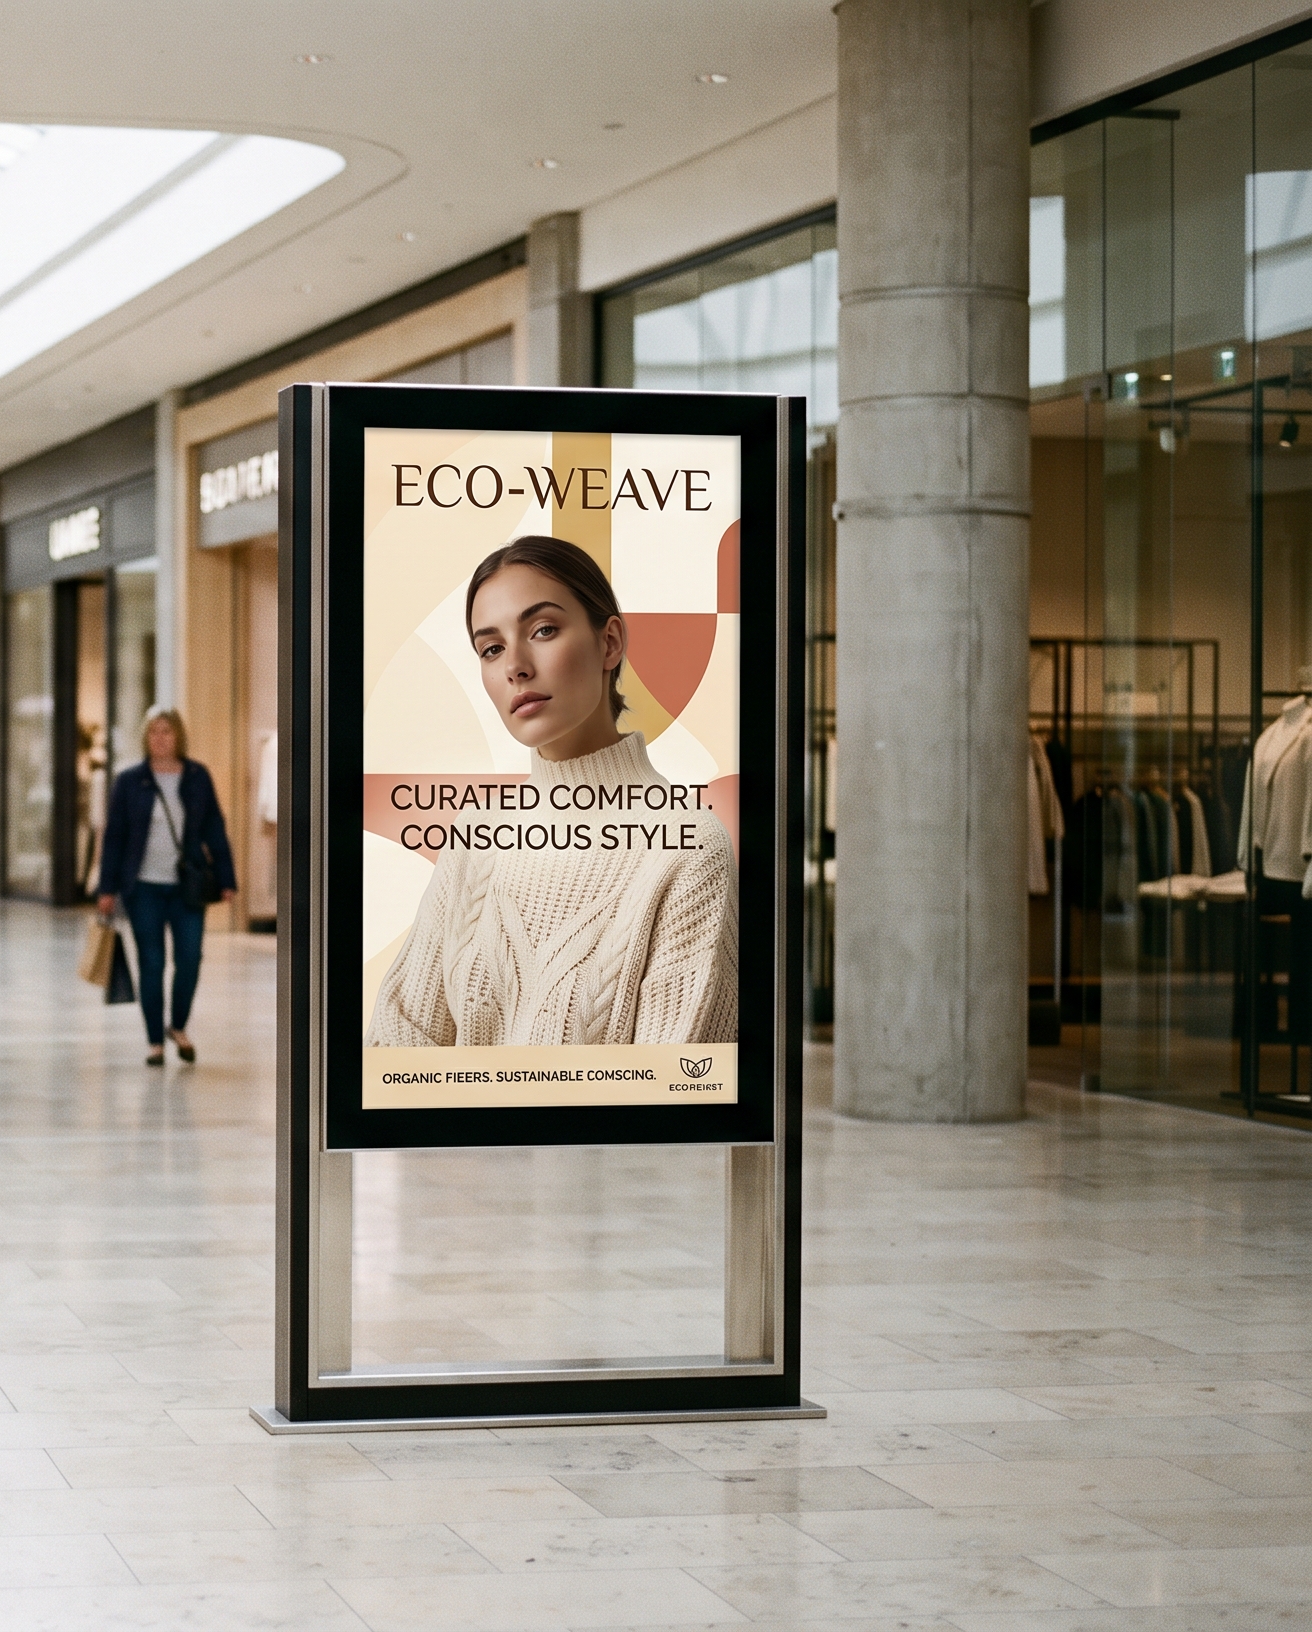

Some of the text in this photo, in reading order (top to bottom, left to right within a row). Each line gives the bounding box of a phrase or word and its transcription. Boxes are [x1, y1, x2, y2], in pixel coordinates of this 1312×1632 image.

[391, 464, 712, 511] ECO-WEAVE
[390, 784, 713, 811] CURATED COMFORT.
[400, 824, 704, 851] CONSCIOUS STYLE.
[382, 1069, 657, 1085] ORGANIC FIEERS. SUSTAINABLE COMSCING.
